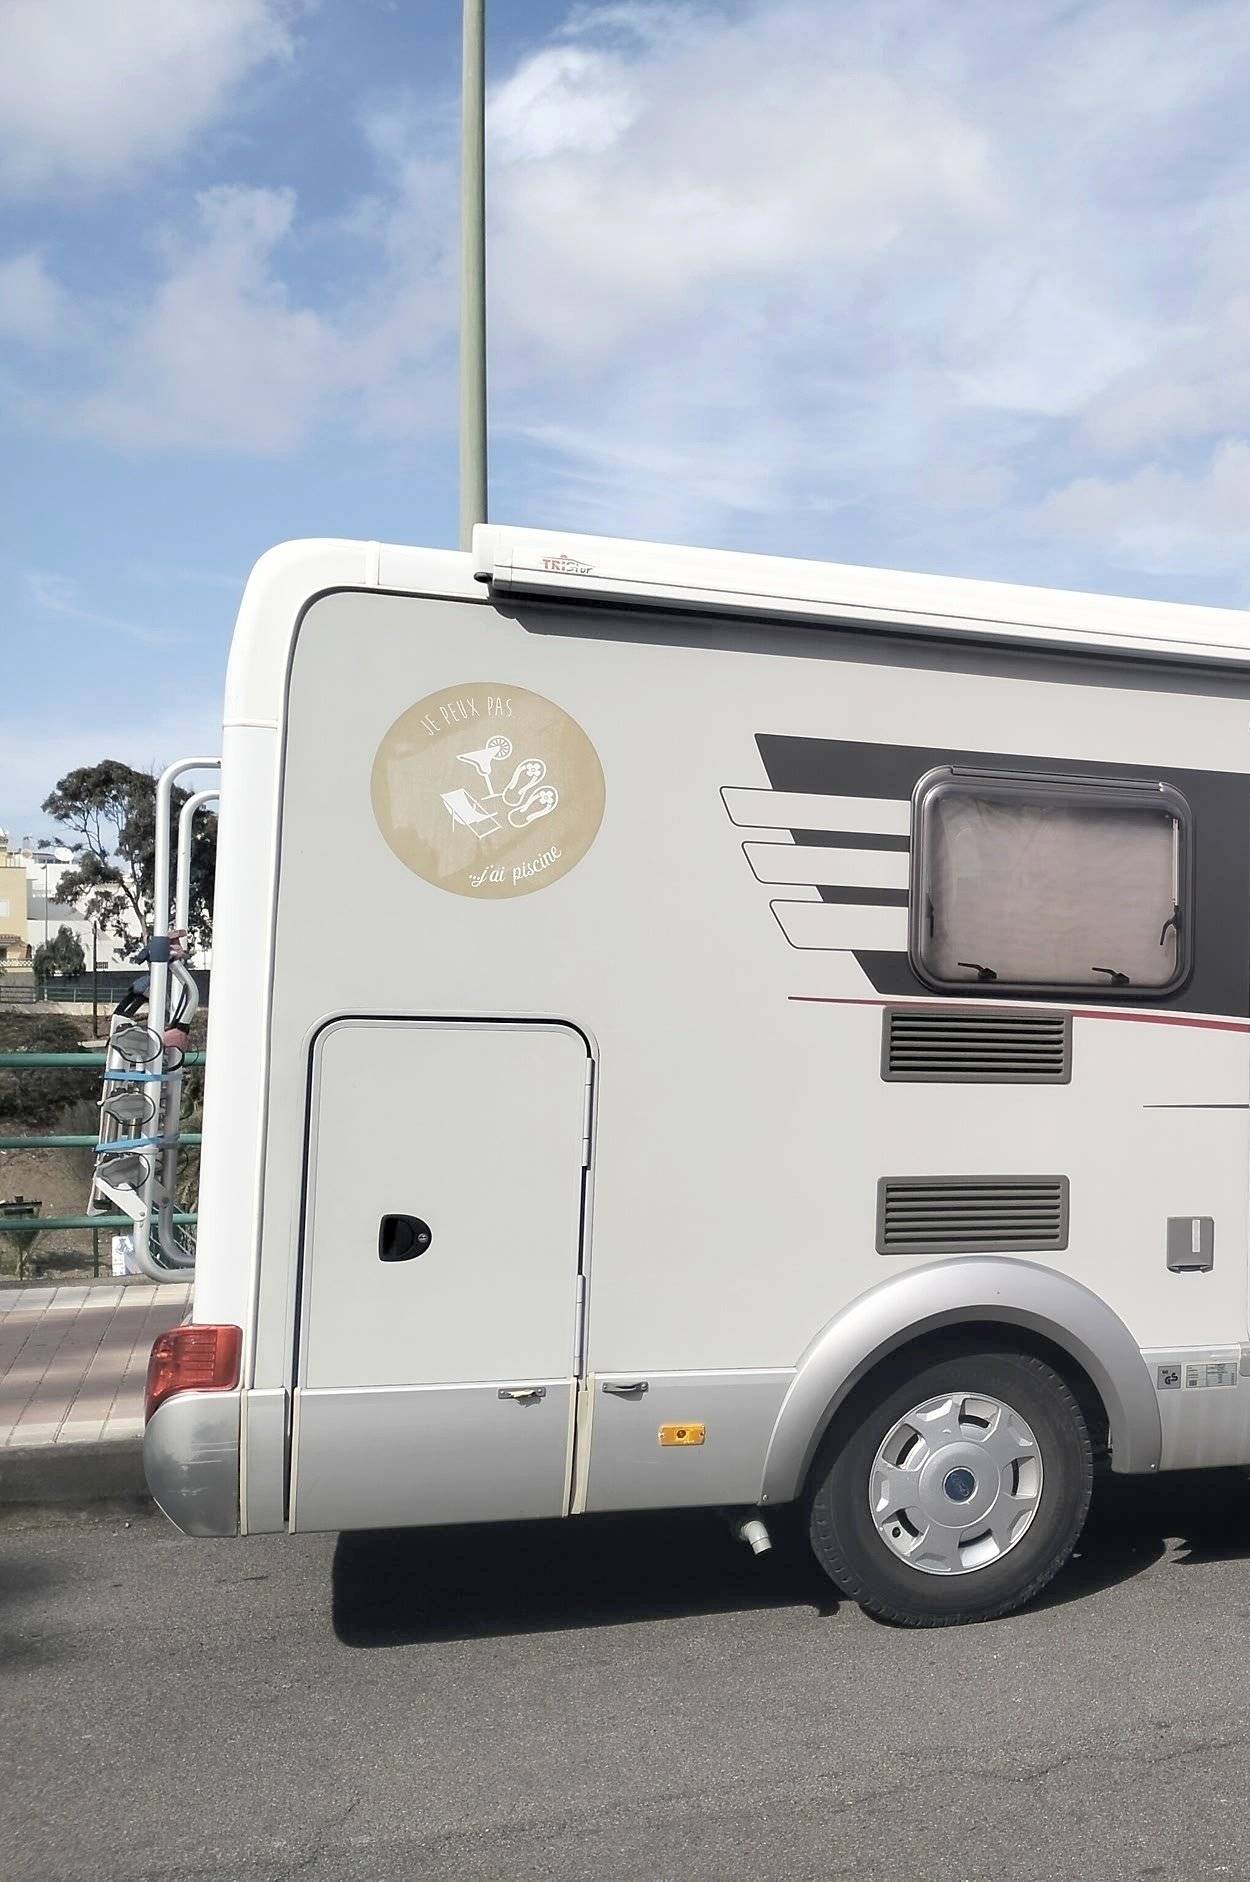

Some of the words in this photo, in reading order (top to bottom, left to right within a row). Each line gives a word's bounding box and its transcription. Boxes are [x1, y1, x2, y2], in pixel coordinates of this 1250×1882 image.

[419, 713, 441, 736] JE
[439, 697, 480, 725] PEUX
[487, 696, 512, 717] PAS
[512, 846, 562, 886] piscine
